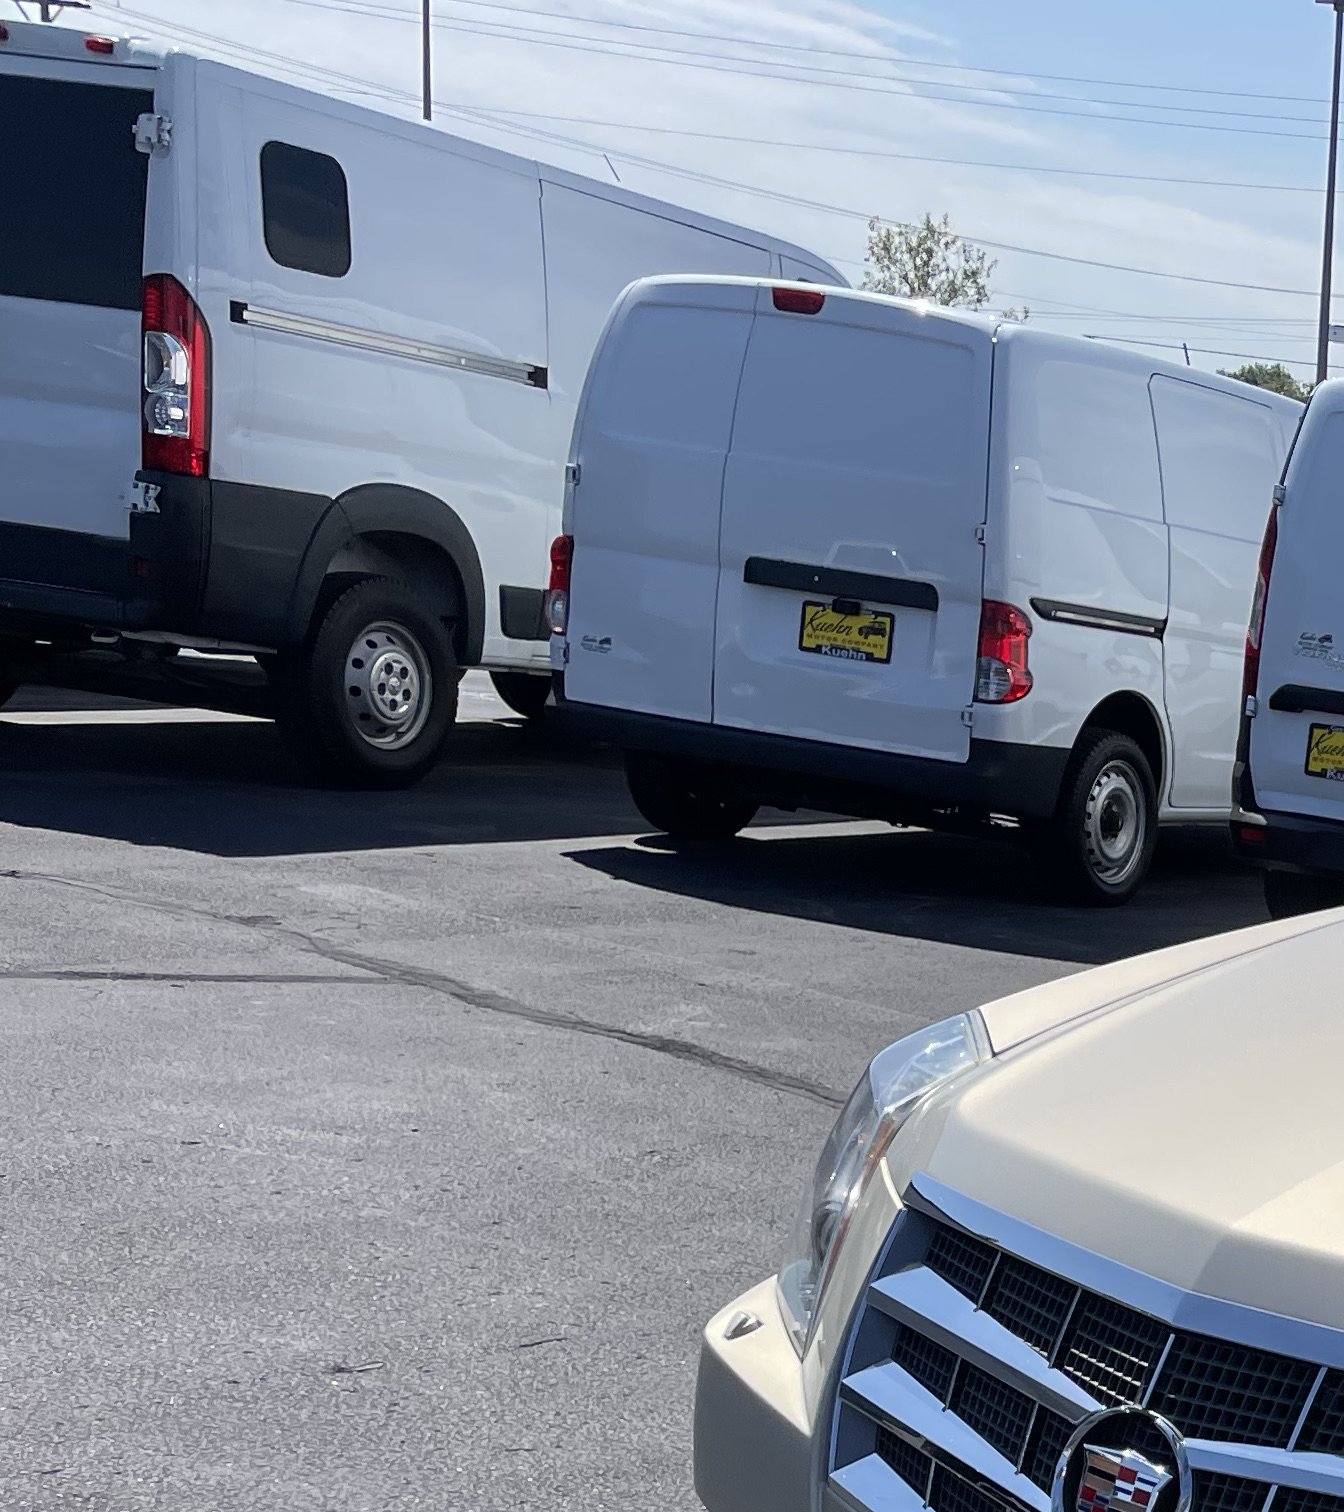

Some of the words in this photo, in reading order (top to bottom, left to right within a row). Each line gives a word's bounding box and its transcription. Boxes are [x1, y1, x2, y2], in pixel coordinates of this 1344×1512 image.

[804, 608, 853, 636] Kuehn
[806, 632, 838, 642] MOTOR
[841, 639, 885, 650] COMPANY
[821, 645, 866, 661] Kuehn
